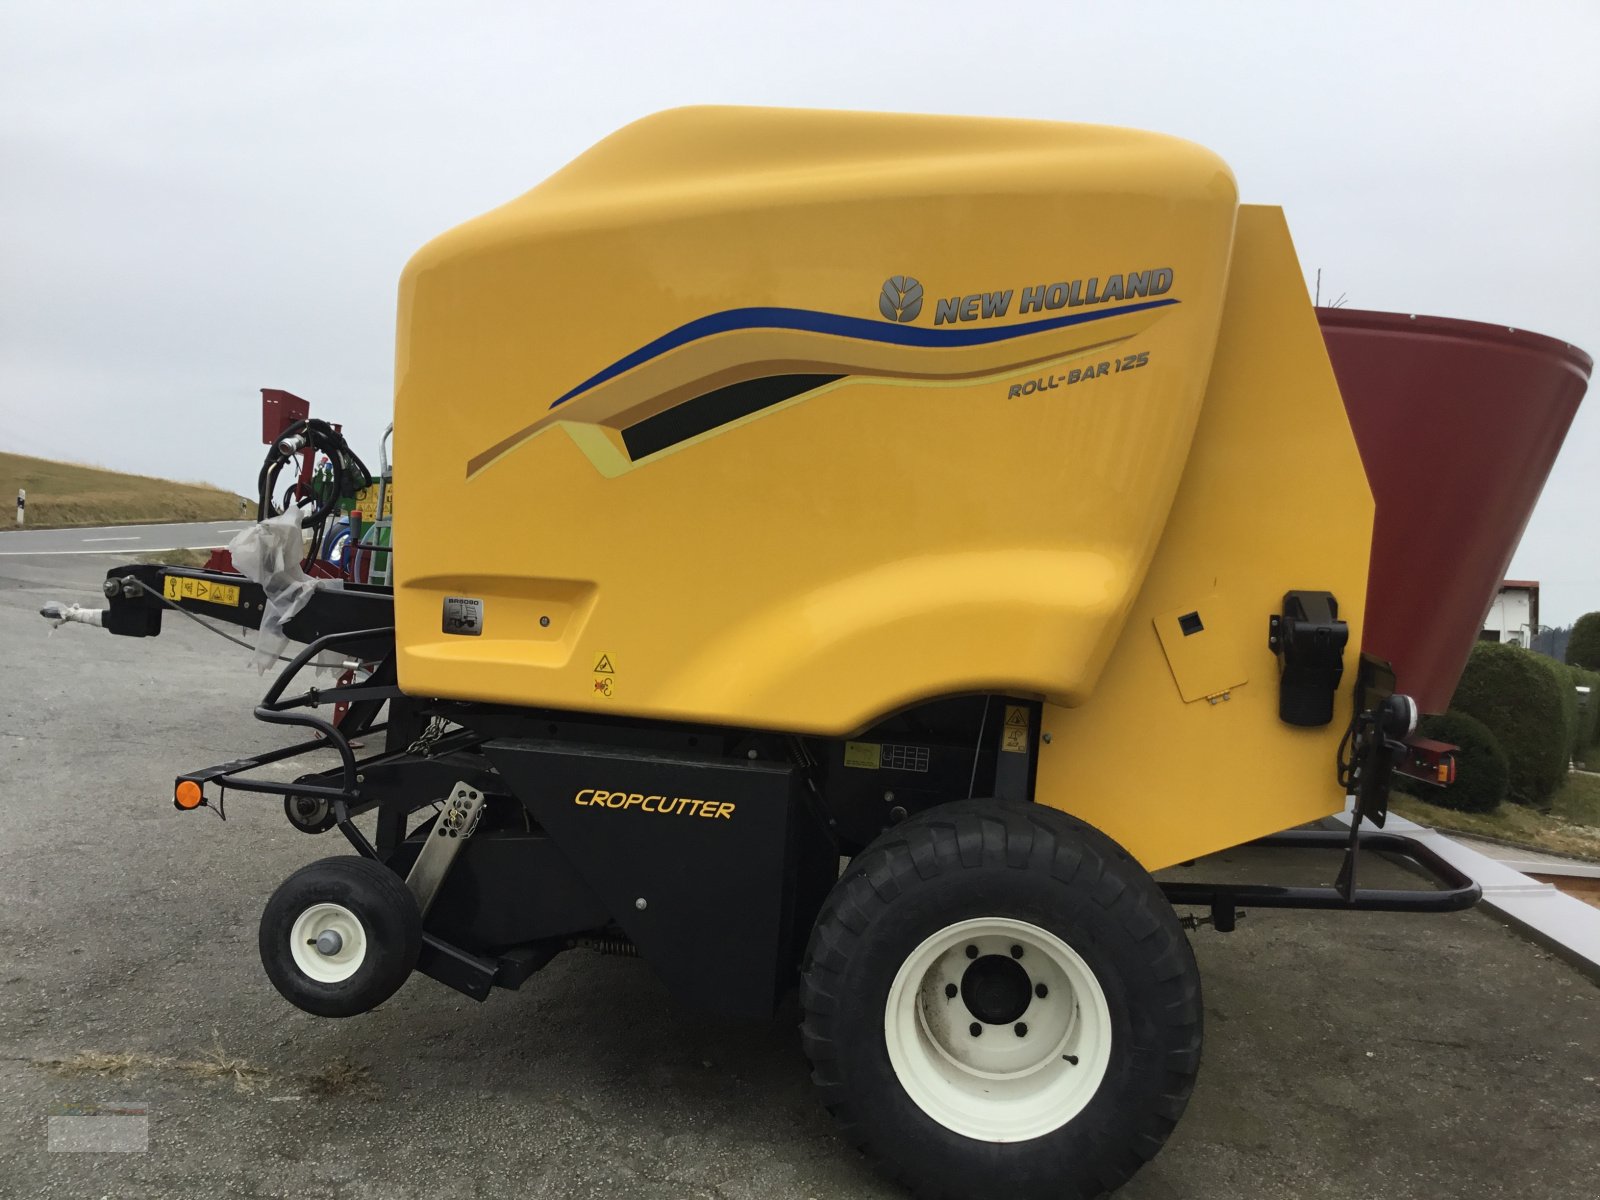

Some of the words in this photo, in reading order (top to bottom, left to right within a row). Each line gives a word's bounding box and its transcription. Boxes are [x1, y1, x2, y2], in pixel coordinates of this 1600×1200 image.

[934, 290, 1013, 325] NEW
[1019, 267, 1173, 314] HOLLAND
[1008, 361, 1109, 400] ROLL-BAR
[1115, 351, 1150, 374] 125
[574, 789, 736, 819] CROPCUTTER
